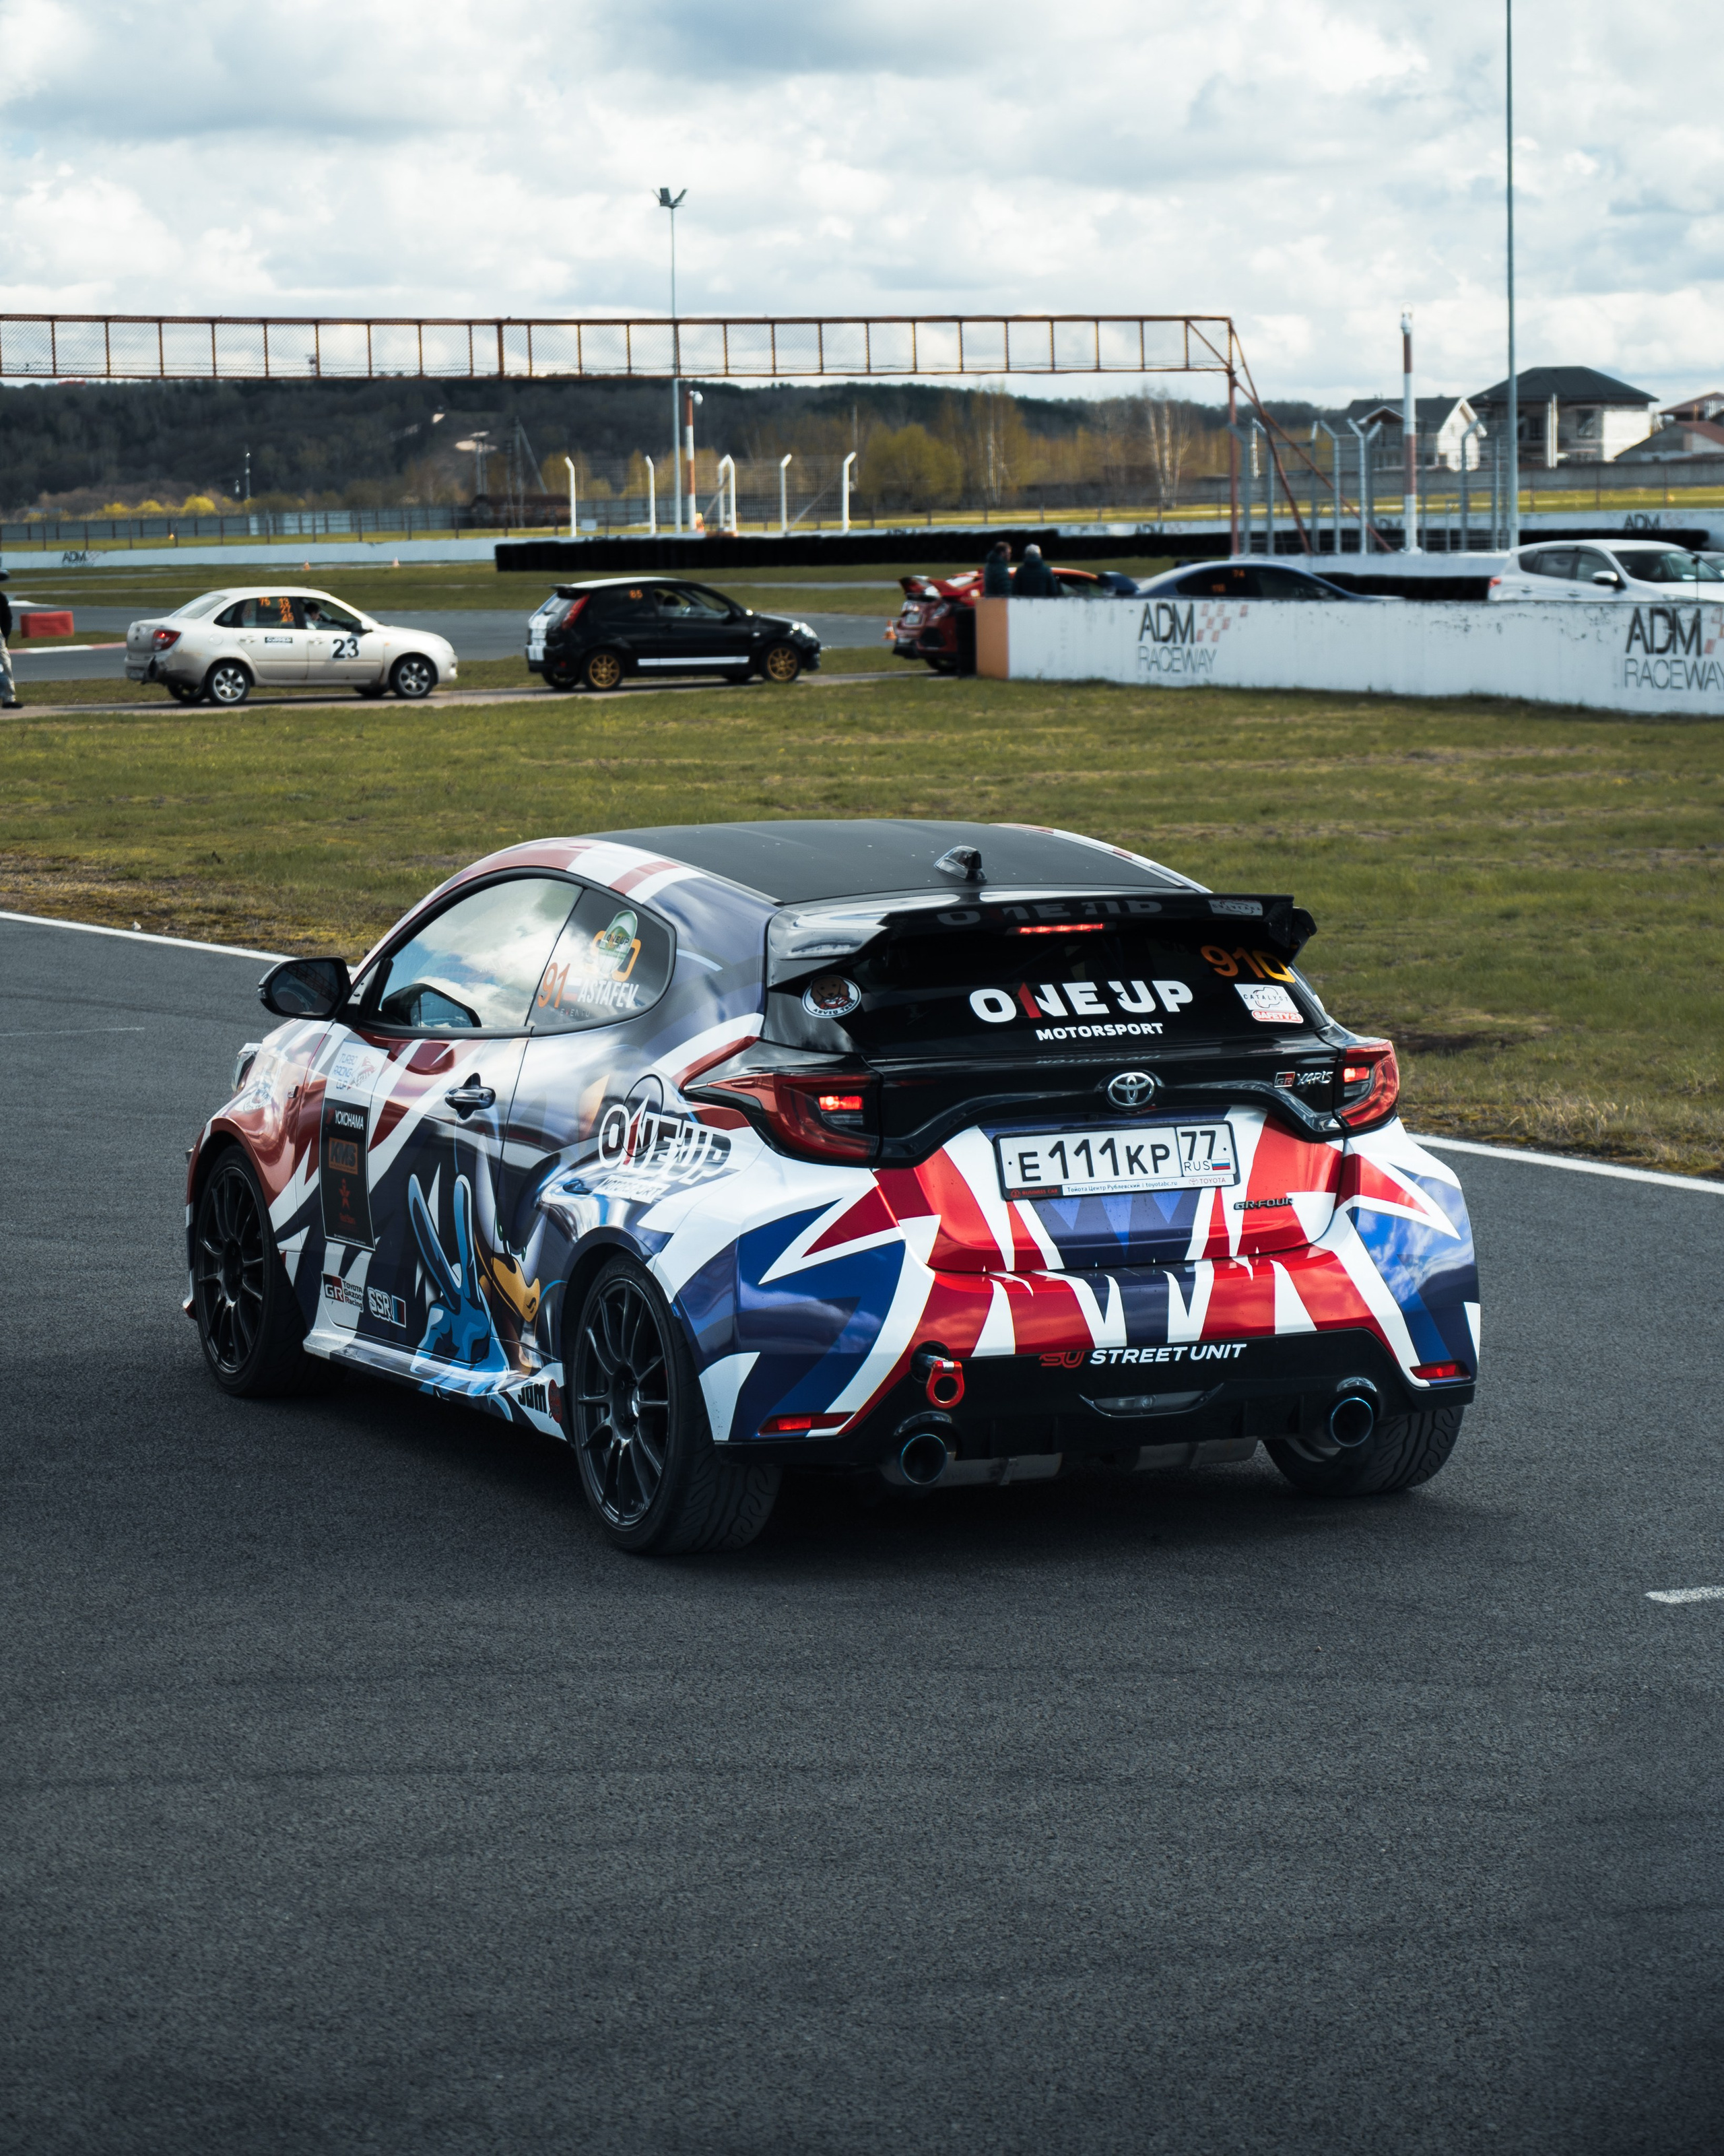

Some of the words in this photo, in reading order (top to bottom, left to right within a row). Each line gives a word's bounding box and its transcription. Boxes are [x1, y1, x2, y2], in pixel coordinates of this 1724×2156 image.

[1138, 602, 1195, 644] ADM
[1625, 607, 1702, 657] ADM
[332, 637, 360, 659] 23
[1138, 645, 1217, 673] RACEWAY
[537, 962, 570, 1008] 91
[577, 979, 639, 1009] ASTAFEV
[1243, 993, 1288, 1002] CATALYST
[1036, 1022, 1163, 1041] MOTORSPORT
[1297, 1070, 1334, 1086] YARIS
[335, 1110, 364, 1131] YOKOHAMA
[1181, 1130, 1216, 1161] 77
[1184, 1161, 1211, 1172] RUS
[325, 1284, 343, 1301] GR
[342, 1280, 363, 1293] TOYOTA
[343, 1288, 362, 1301] GAZOO
[344, 1296, 363, 1311] Racing
[368, 1288, 391, 1318] SSR
